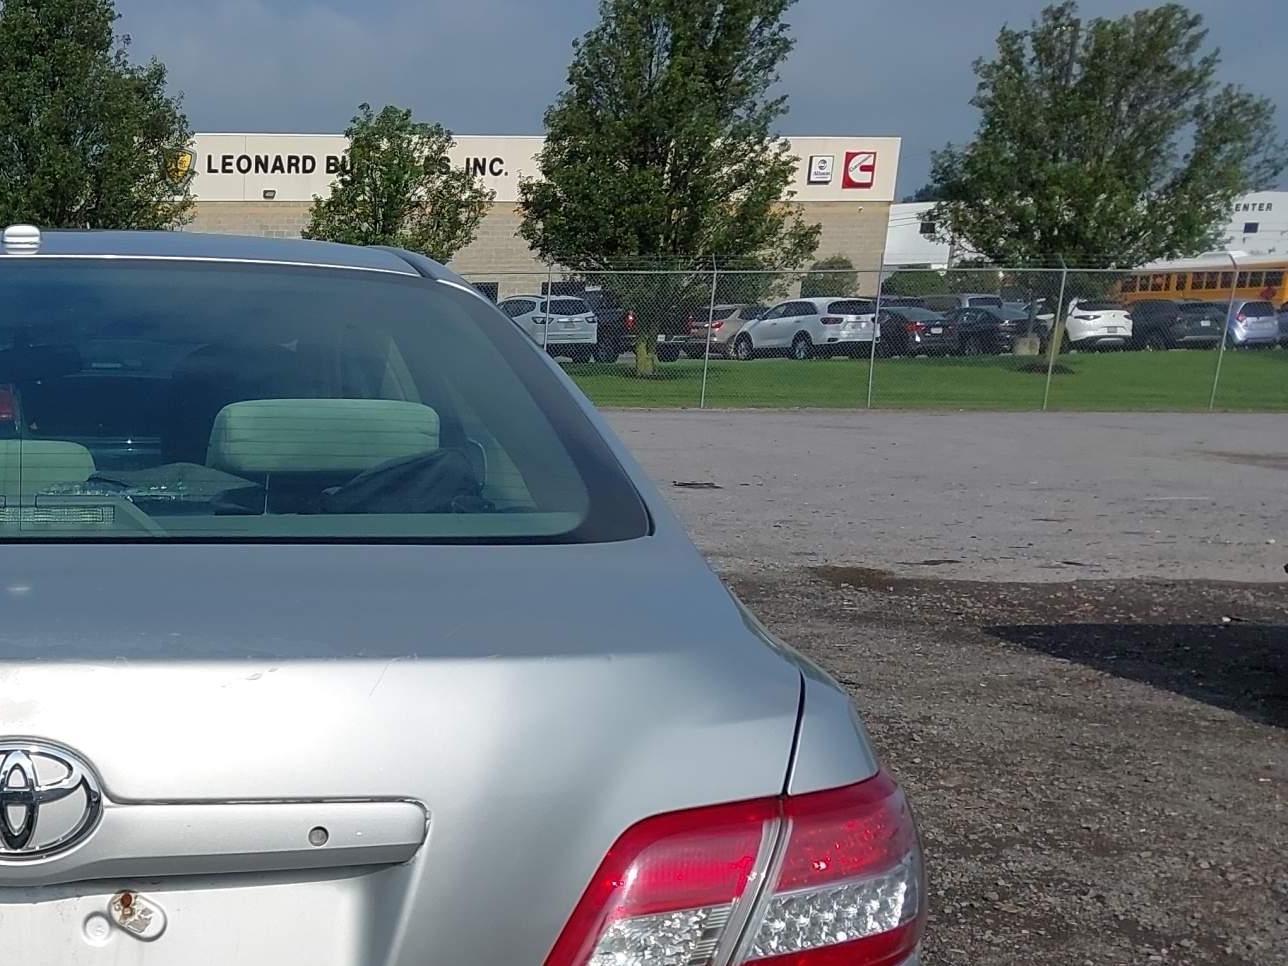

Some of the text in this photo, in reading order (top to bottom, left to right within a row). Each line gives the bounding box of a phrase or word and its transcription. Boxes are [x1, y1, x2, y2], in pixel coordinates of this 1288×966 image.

[206, 154, 317, 174] LEONARD
[325, 155, 356, 175] BU
[465, 156, 509, 177] INC.
